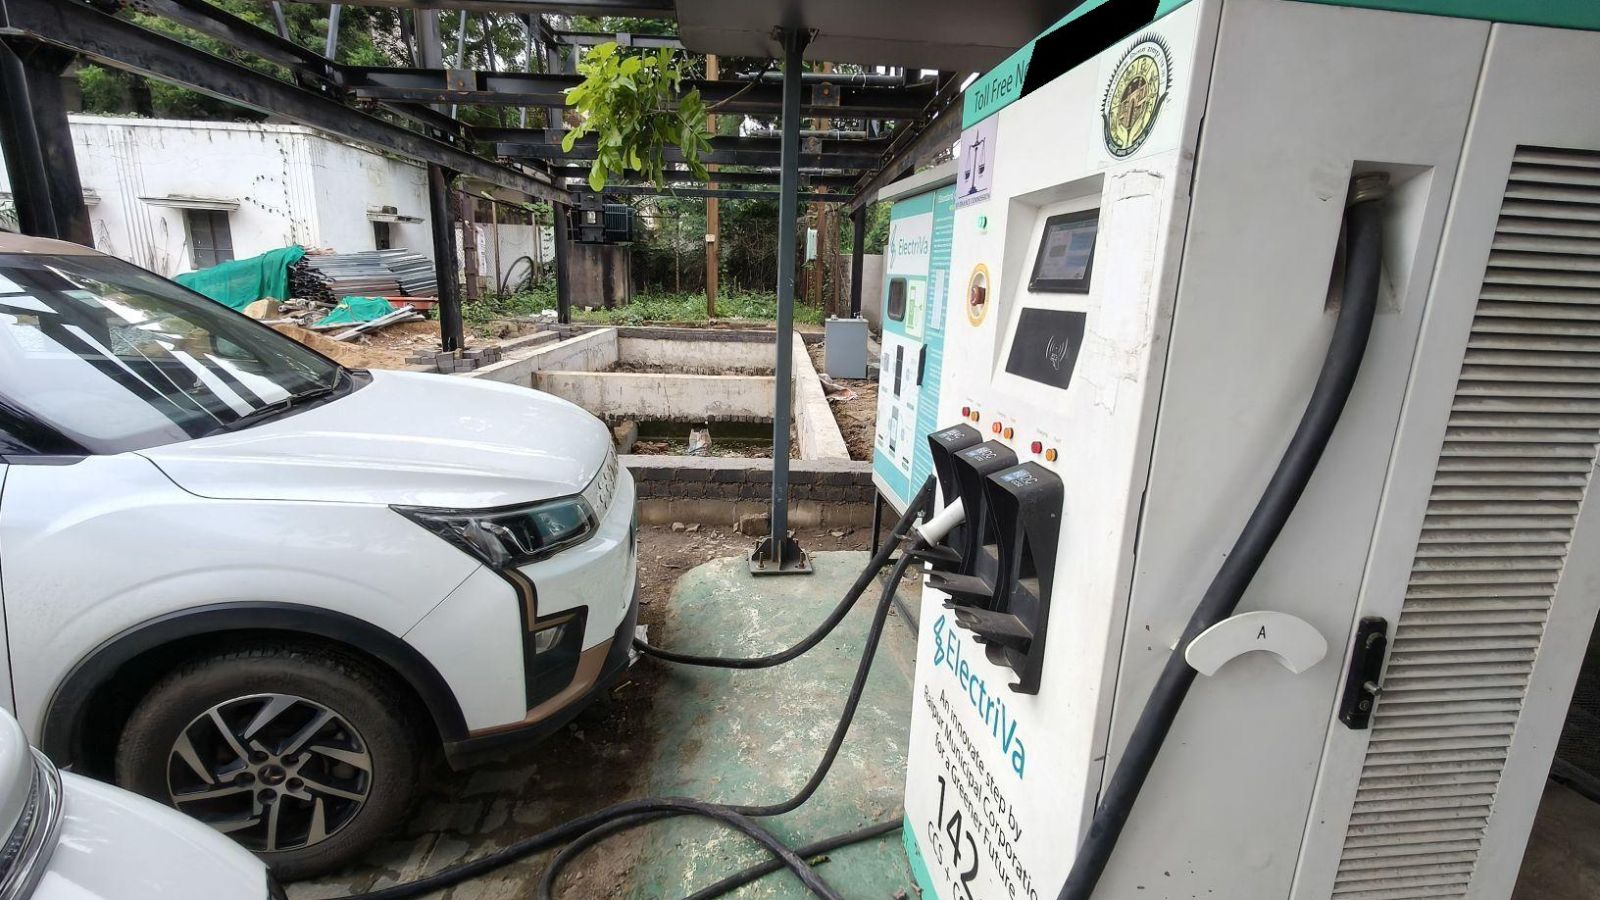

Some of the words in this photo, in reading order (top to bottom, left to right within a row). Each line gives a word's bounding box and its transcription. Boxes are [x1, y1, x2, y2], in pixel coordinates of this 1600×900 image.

[975, 82, 990, 112] Toll
[991, 74, 1013, 103] Free
[946, 628, 1025, 780] ElectriVa
[1257, 625, 1266, 639] A
[935, 732, 945, 758] for
[945, 757, 950, 771] a
[951, 765, 982, 833] Greener
[983, 827, 1016, 900] Future
[940, 689, 950, 714] An
[950, 705, 985, 775] innovate
[986, 772, 1006, 814] step
[1008, 805, 1022, 842] by
[944, 723, 982, 803] Municipal
[983, 796, 1038, 900] Corporatio
[928, 820, 944, 865] CCS
